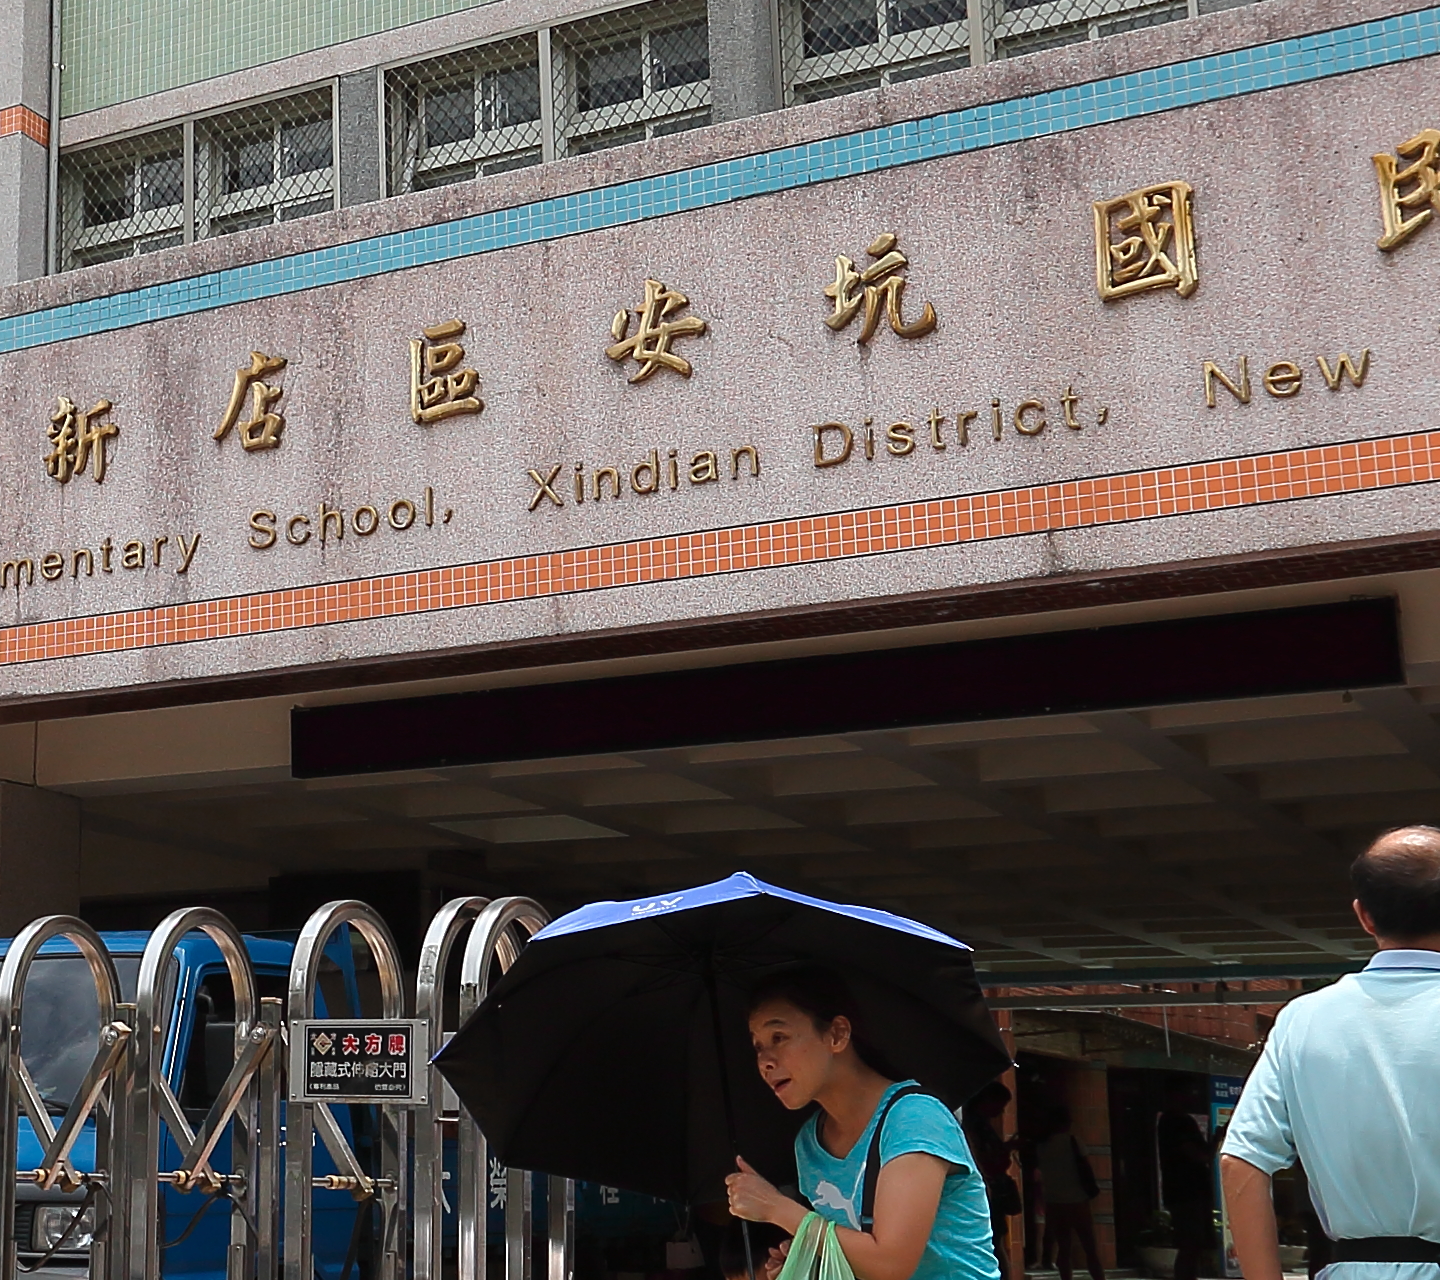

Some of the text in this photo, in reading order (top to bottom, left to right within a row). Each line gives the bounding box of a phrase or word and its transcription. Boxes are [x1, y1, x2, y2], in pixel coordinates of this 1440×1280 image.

[248, 485, 454, 550] School,
[526, 439, 761, 512] Xindian
[812, 385, 1110, 469] District,
[1202, 347, 1372, 409] New
[341, 1032, 407, 1056] 大方牌
